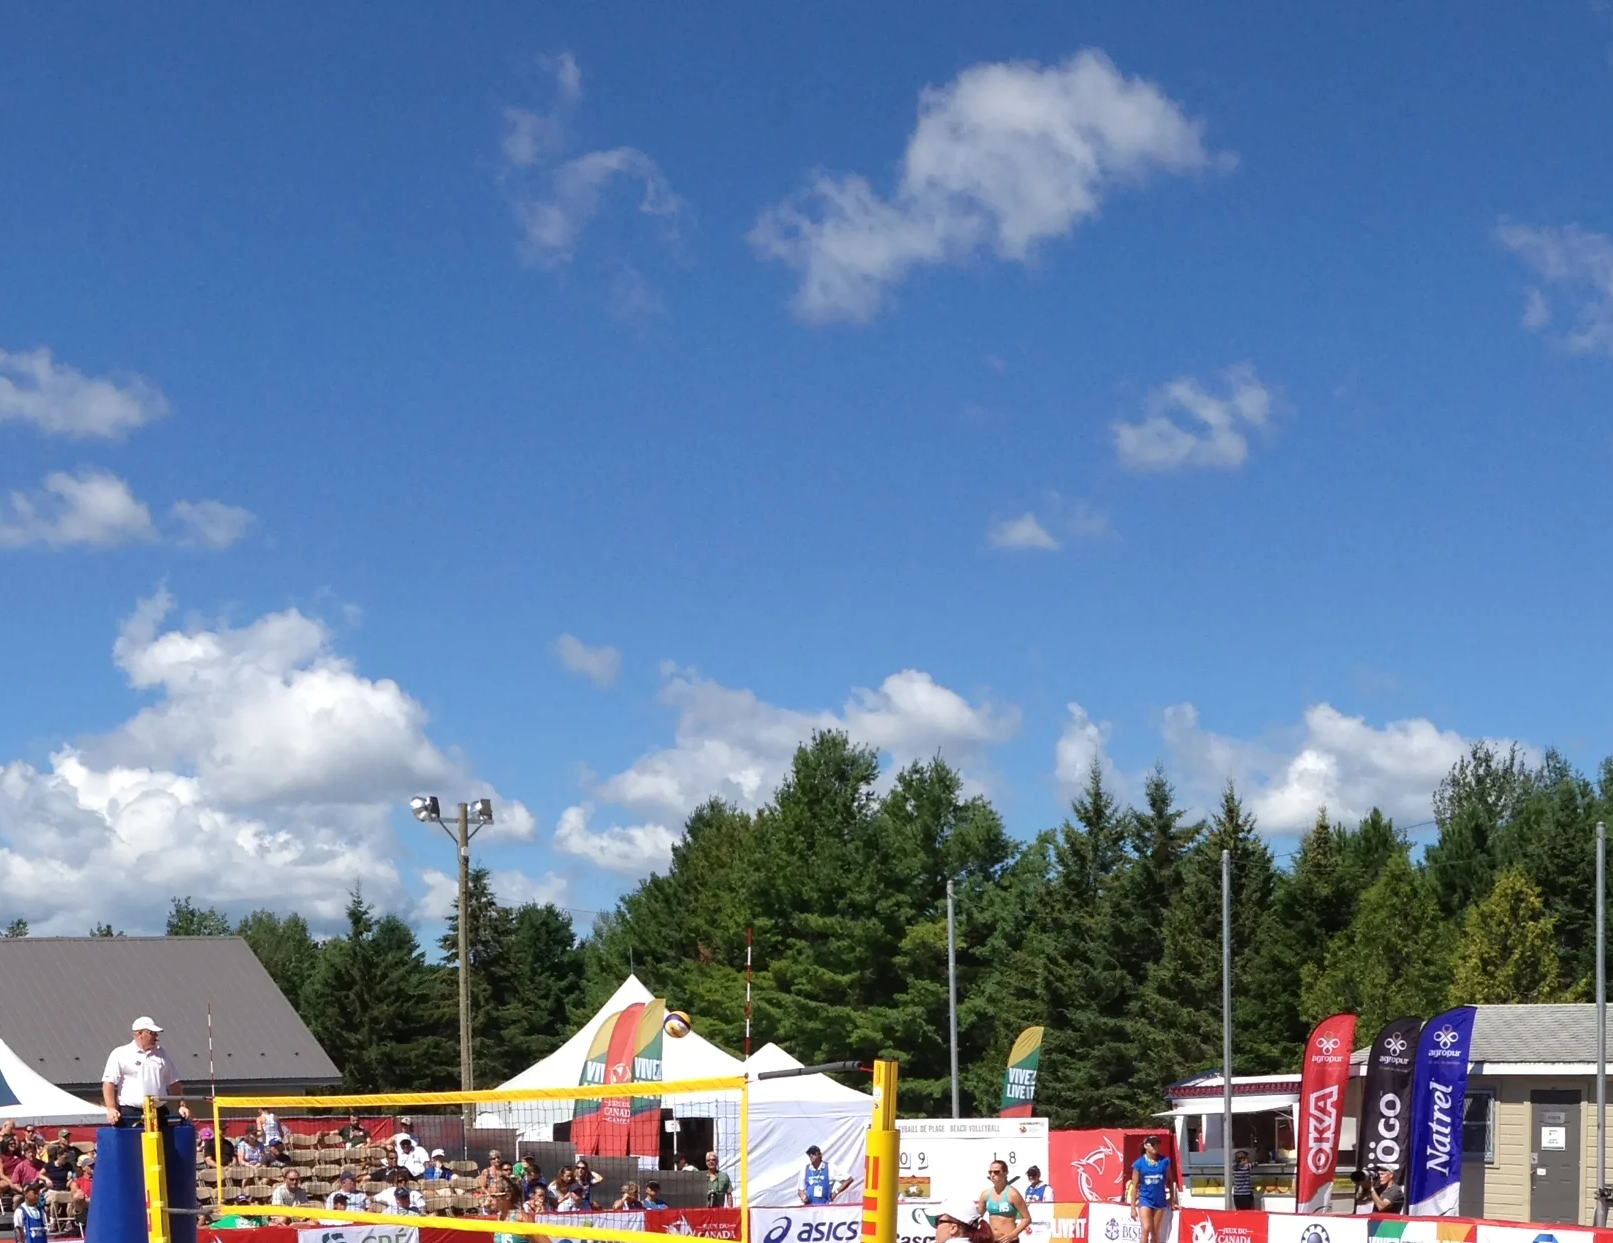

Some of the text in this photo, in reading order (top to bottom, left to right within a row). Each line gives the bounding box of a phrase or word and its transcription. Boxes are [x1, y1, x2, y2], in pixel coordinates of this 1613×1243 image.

[1311, 1054, 1344, 1064] agropur
[1428, 1048, 1462, 1058] agropur
[1379, 1054, 1410, 1066] agropur
[1008, 1067, 1037, 1086] VIVEZ
[1006, 1083, 1035, 1100] LIVE IT
[604, 1107, 631, 1118] CANAD
[920, 1124, 1001, 1133] DE PLAGE BEACH VOLLEYBALL
[1307, 1084, 1339, 1176] OKA
[1426, 1078, 1454, 1177] Natrel
[797, 1220, 860, 1243] asics
[1052, 1218, 1086, 1239] LIVE IT
[1222, 1227, 1236, 1235] JEUX
[694, 1230, 737, 1240] CANADA
